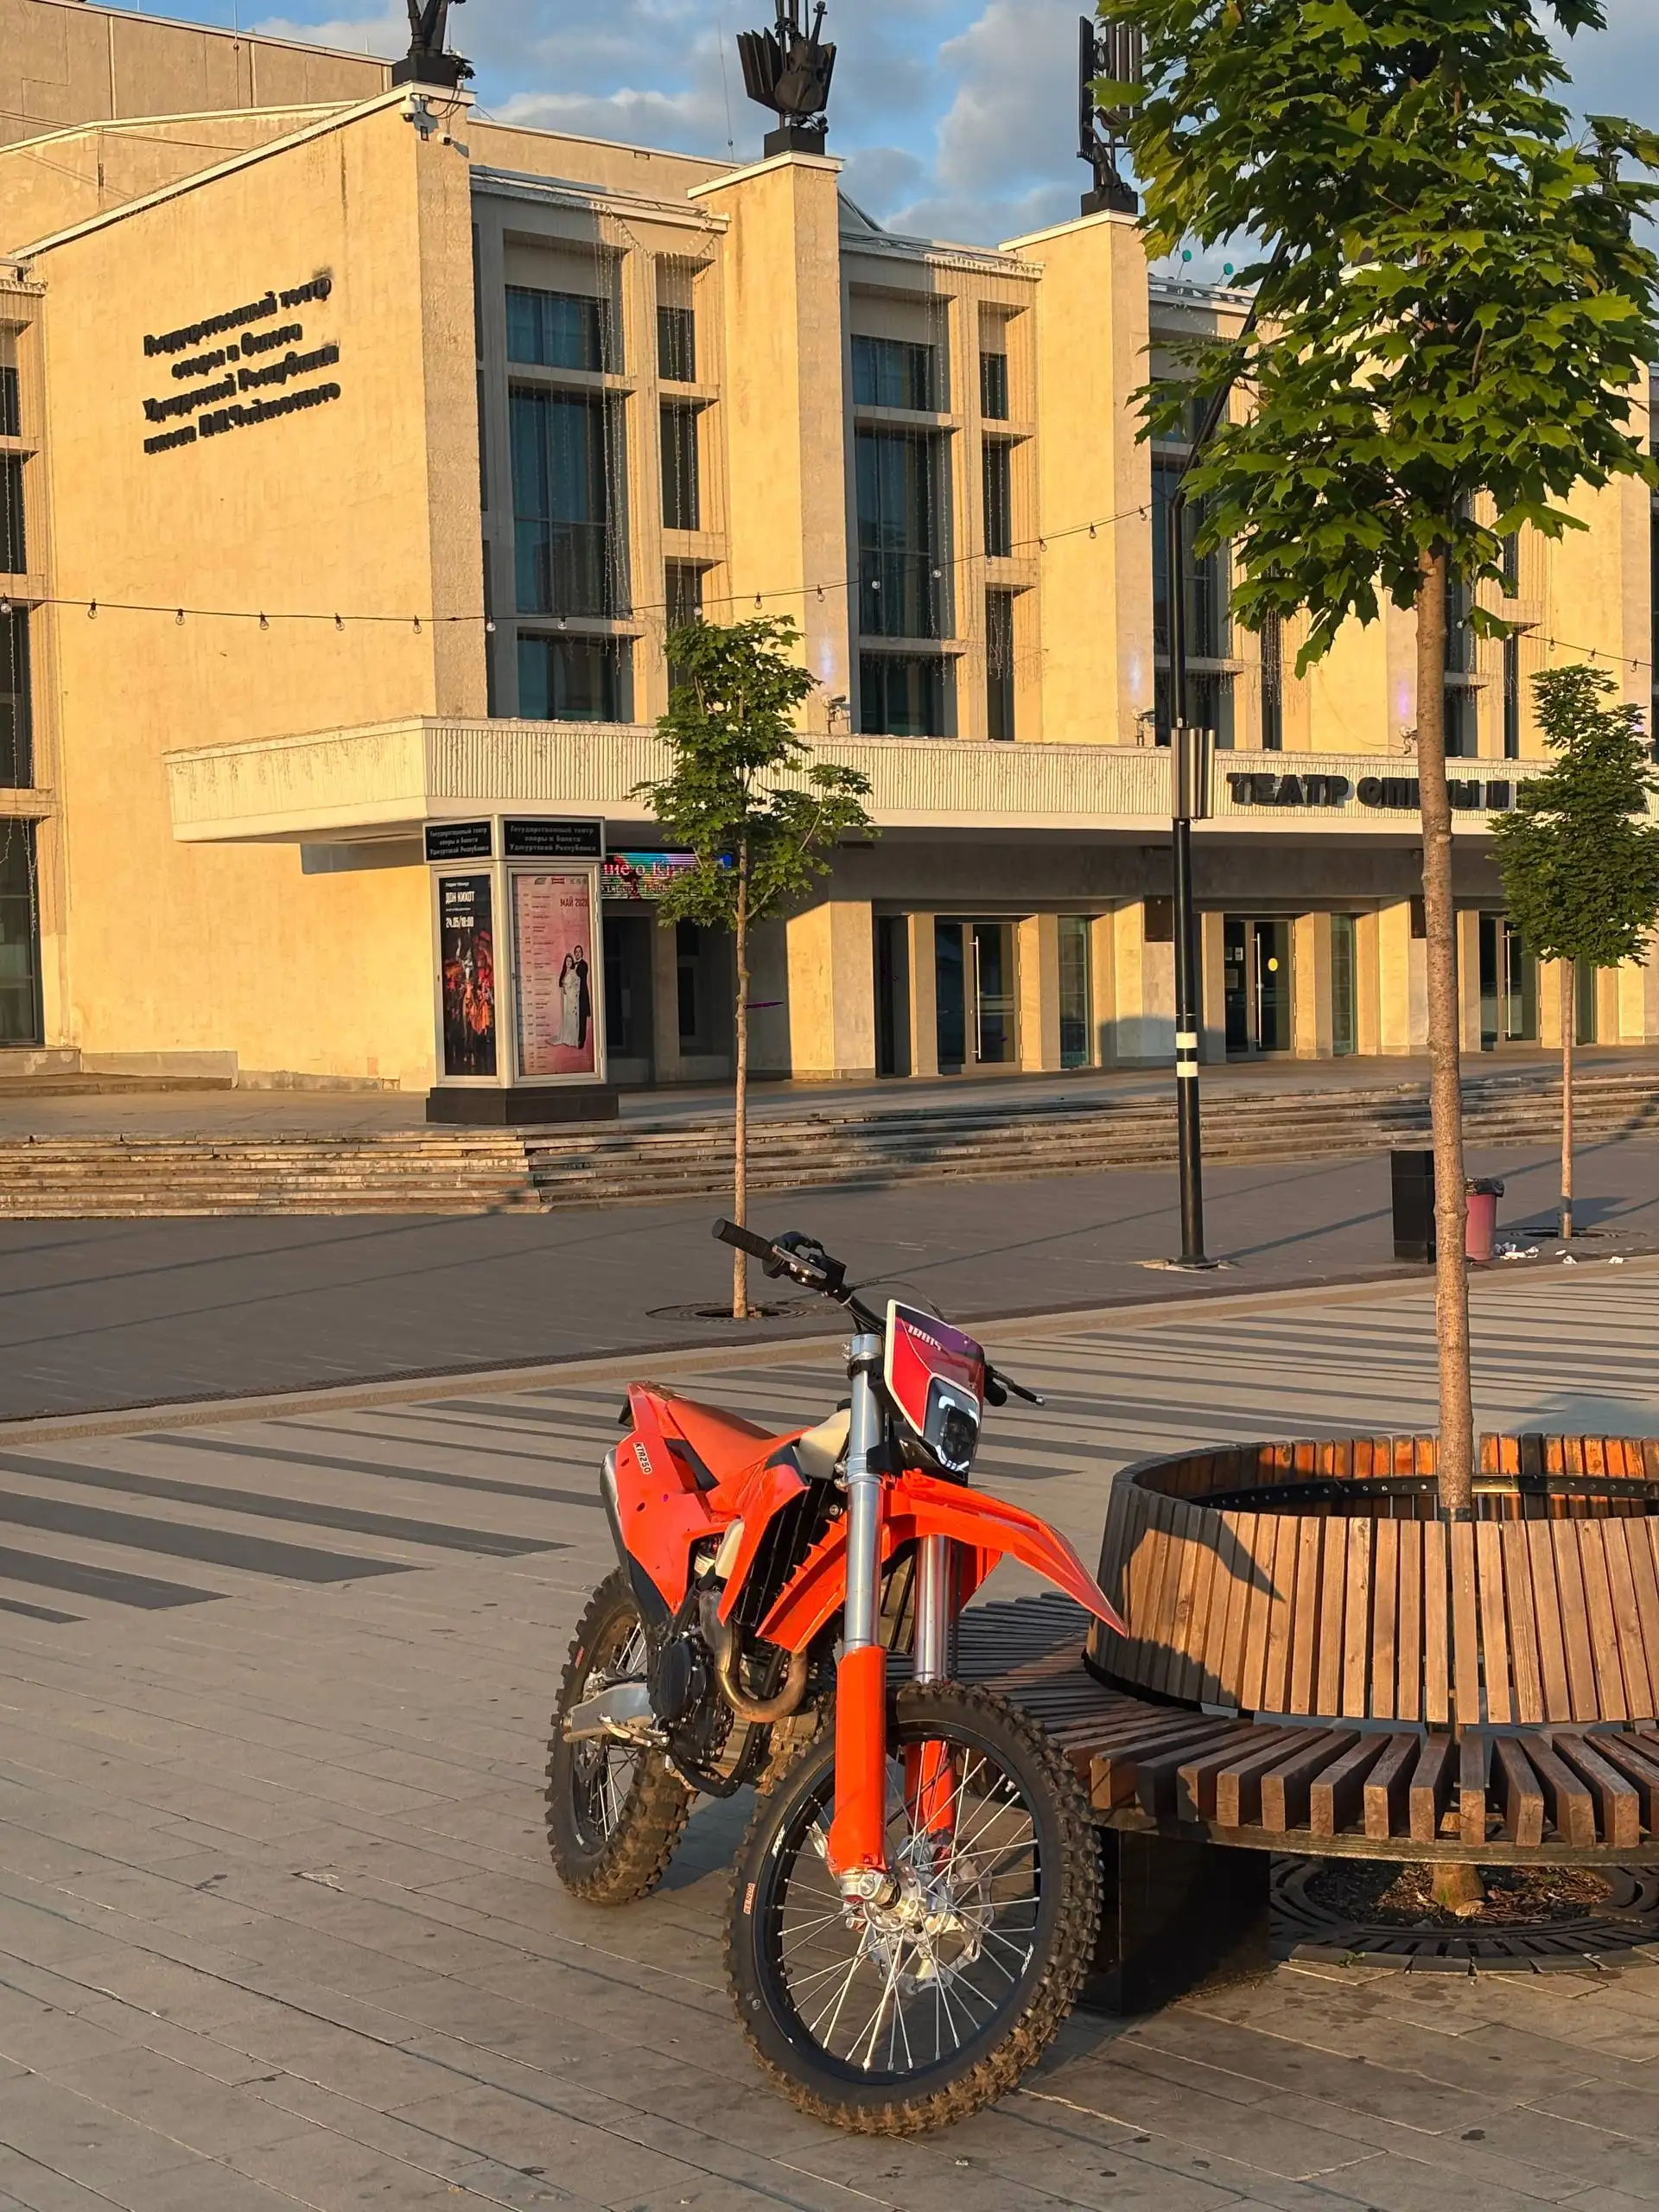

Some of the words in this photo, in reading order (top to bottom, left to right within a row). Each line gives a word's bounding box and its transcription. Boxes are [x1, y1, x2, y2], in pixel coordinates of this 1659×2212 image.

[279, 278, 332, 308] театр
[171, 349, 226, 379] оперы
[226, 345, 240, 363] и
[143, 373, 236, 423] Удмуртской
[238, 346, 339, 391] Республики
[143, 425, 197, 455] имени
[1226, 772, 1351, 807] ТЕАТР
[1486, 780, 1510, 809] И
[574, 827, 594, 836] театр
[560, 895, 574, 907] МАЙ
[635, 1443, 651, 1473] KTA250
